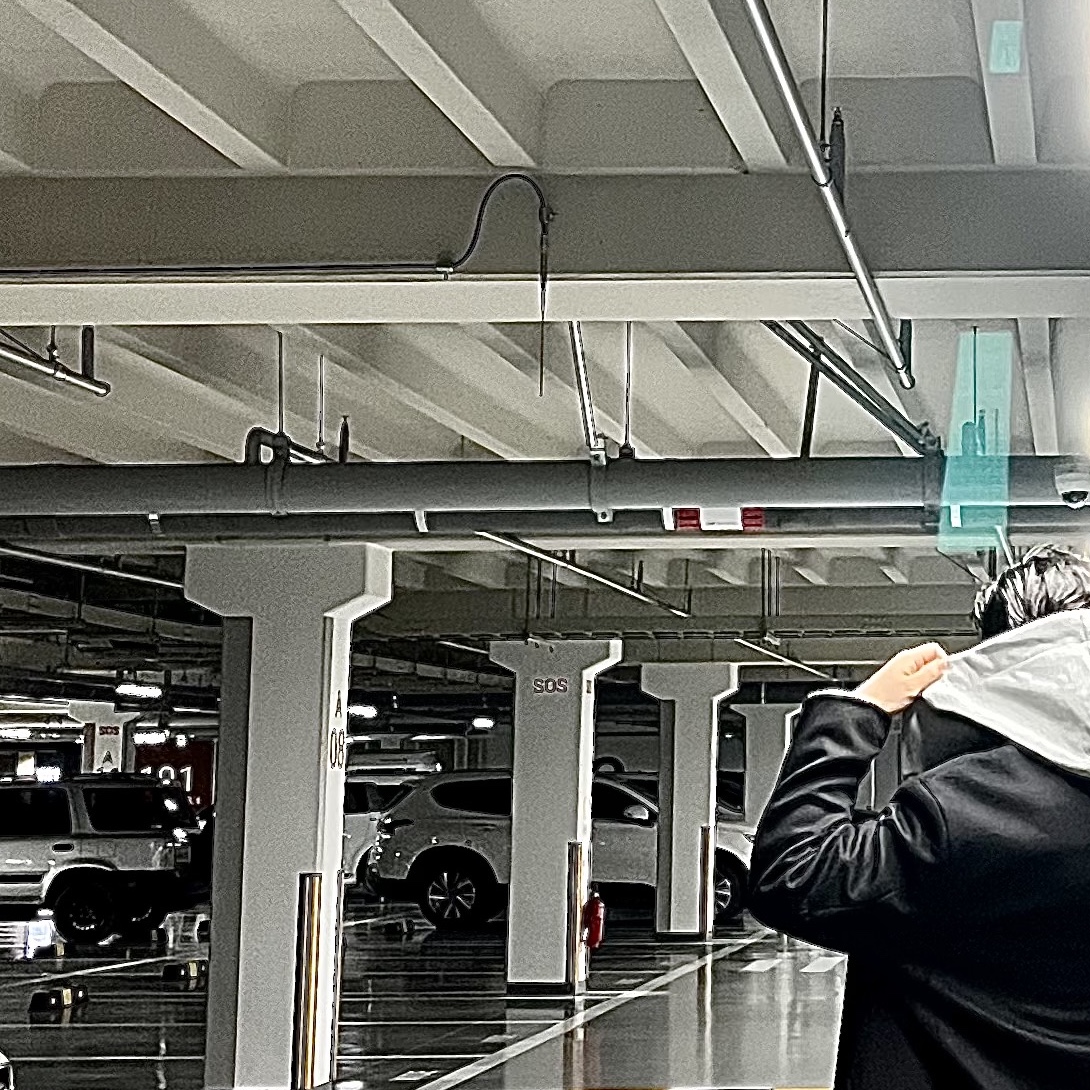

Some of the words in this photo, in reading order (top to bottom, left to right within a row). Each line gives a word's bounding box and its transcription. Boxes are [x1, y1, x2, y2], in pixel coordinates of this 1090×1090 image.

[533, 678, 568, 694] SOS
[334, 690, 342, 718] A
[99, 726, 120, 736] SOS
[330, 728, 345, 769] 08
[102, 750, 113, 764] A
